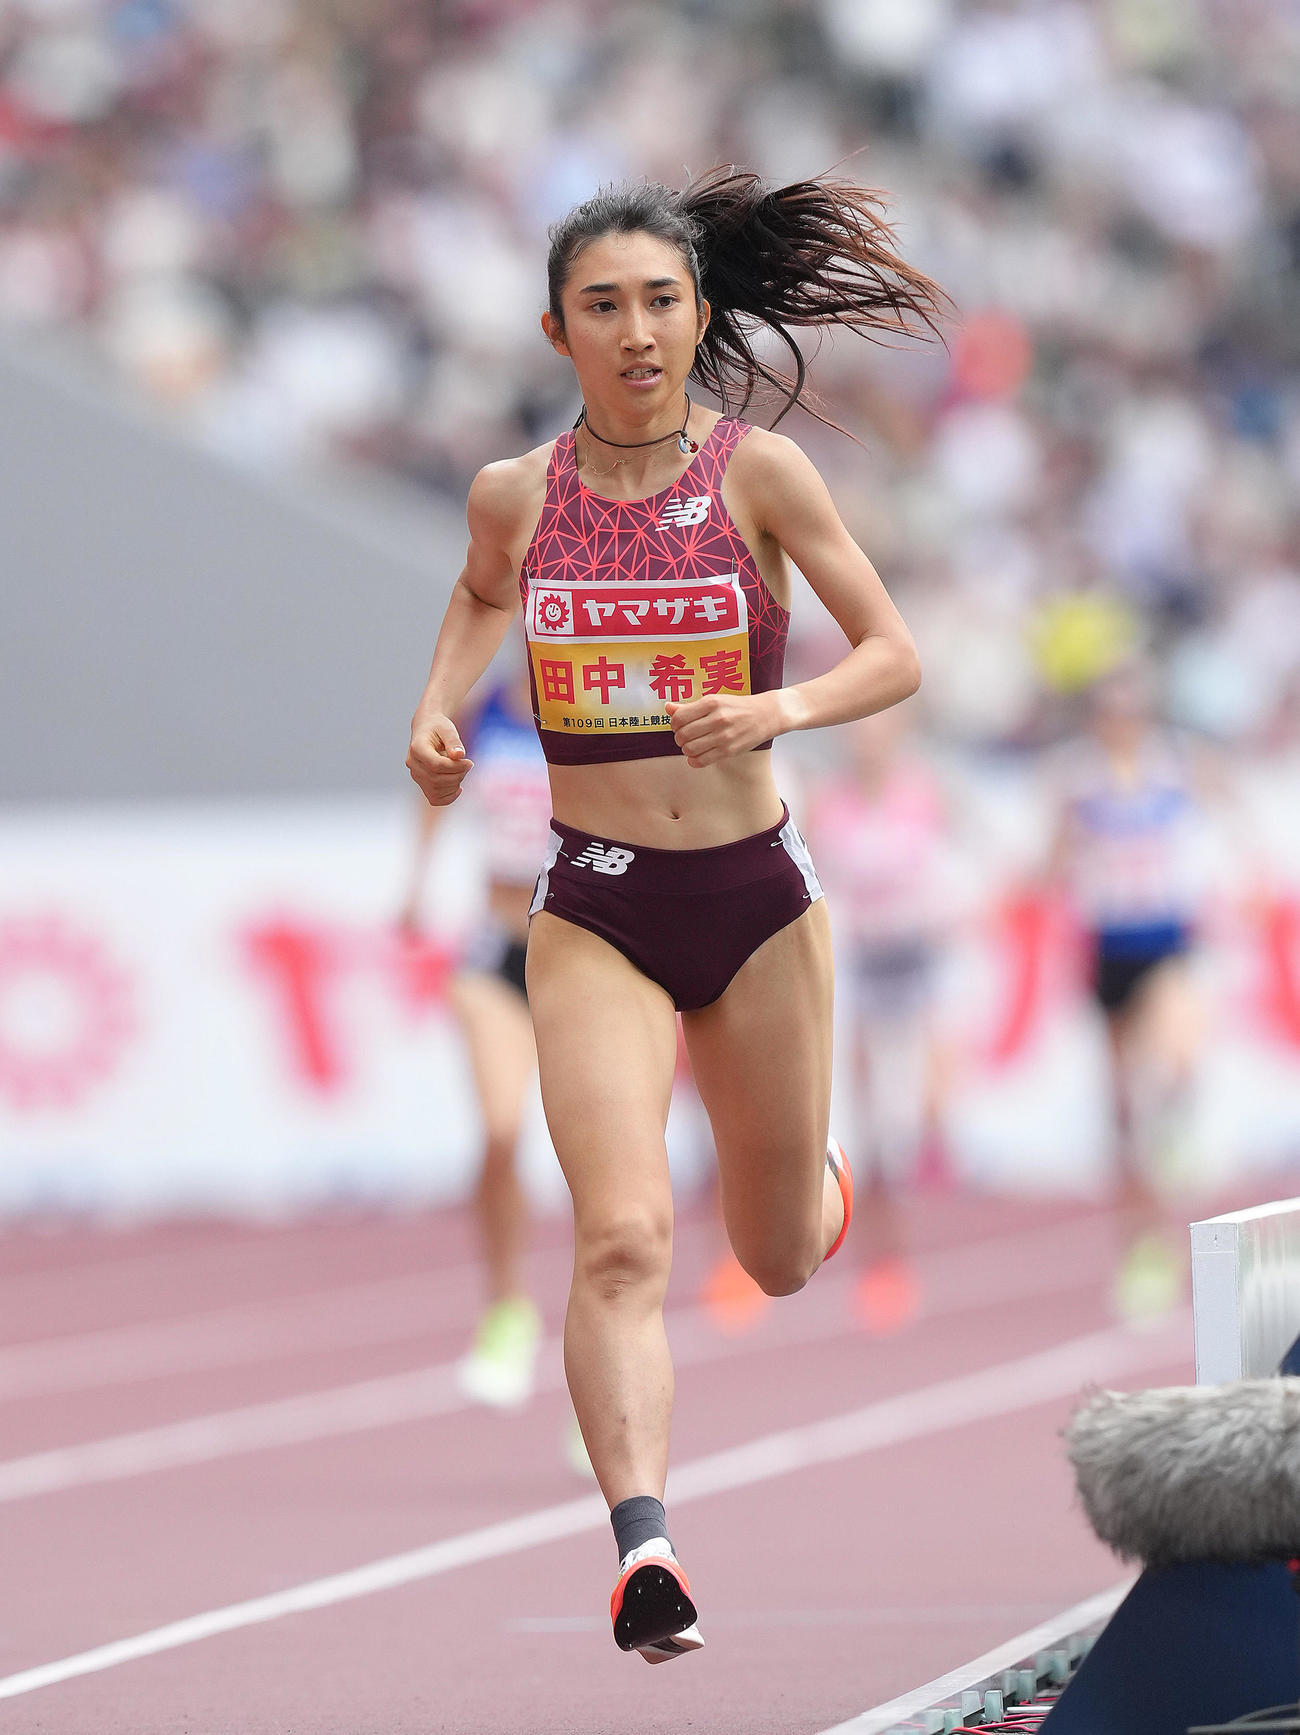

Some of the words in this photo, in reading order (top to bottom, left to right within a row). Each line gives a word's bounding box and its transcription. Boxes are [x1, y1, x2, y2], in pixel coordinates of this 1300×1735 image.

[655, 495, 712, 531] NB
[582, 595, 729, 627] ヤマザキ
[539, 655, 626, 706] 田中
[648, 649, 745, 703] 希実
[562, 717, 605, 729] 第109回
[570, 842, 635, 876] NB
